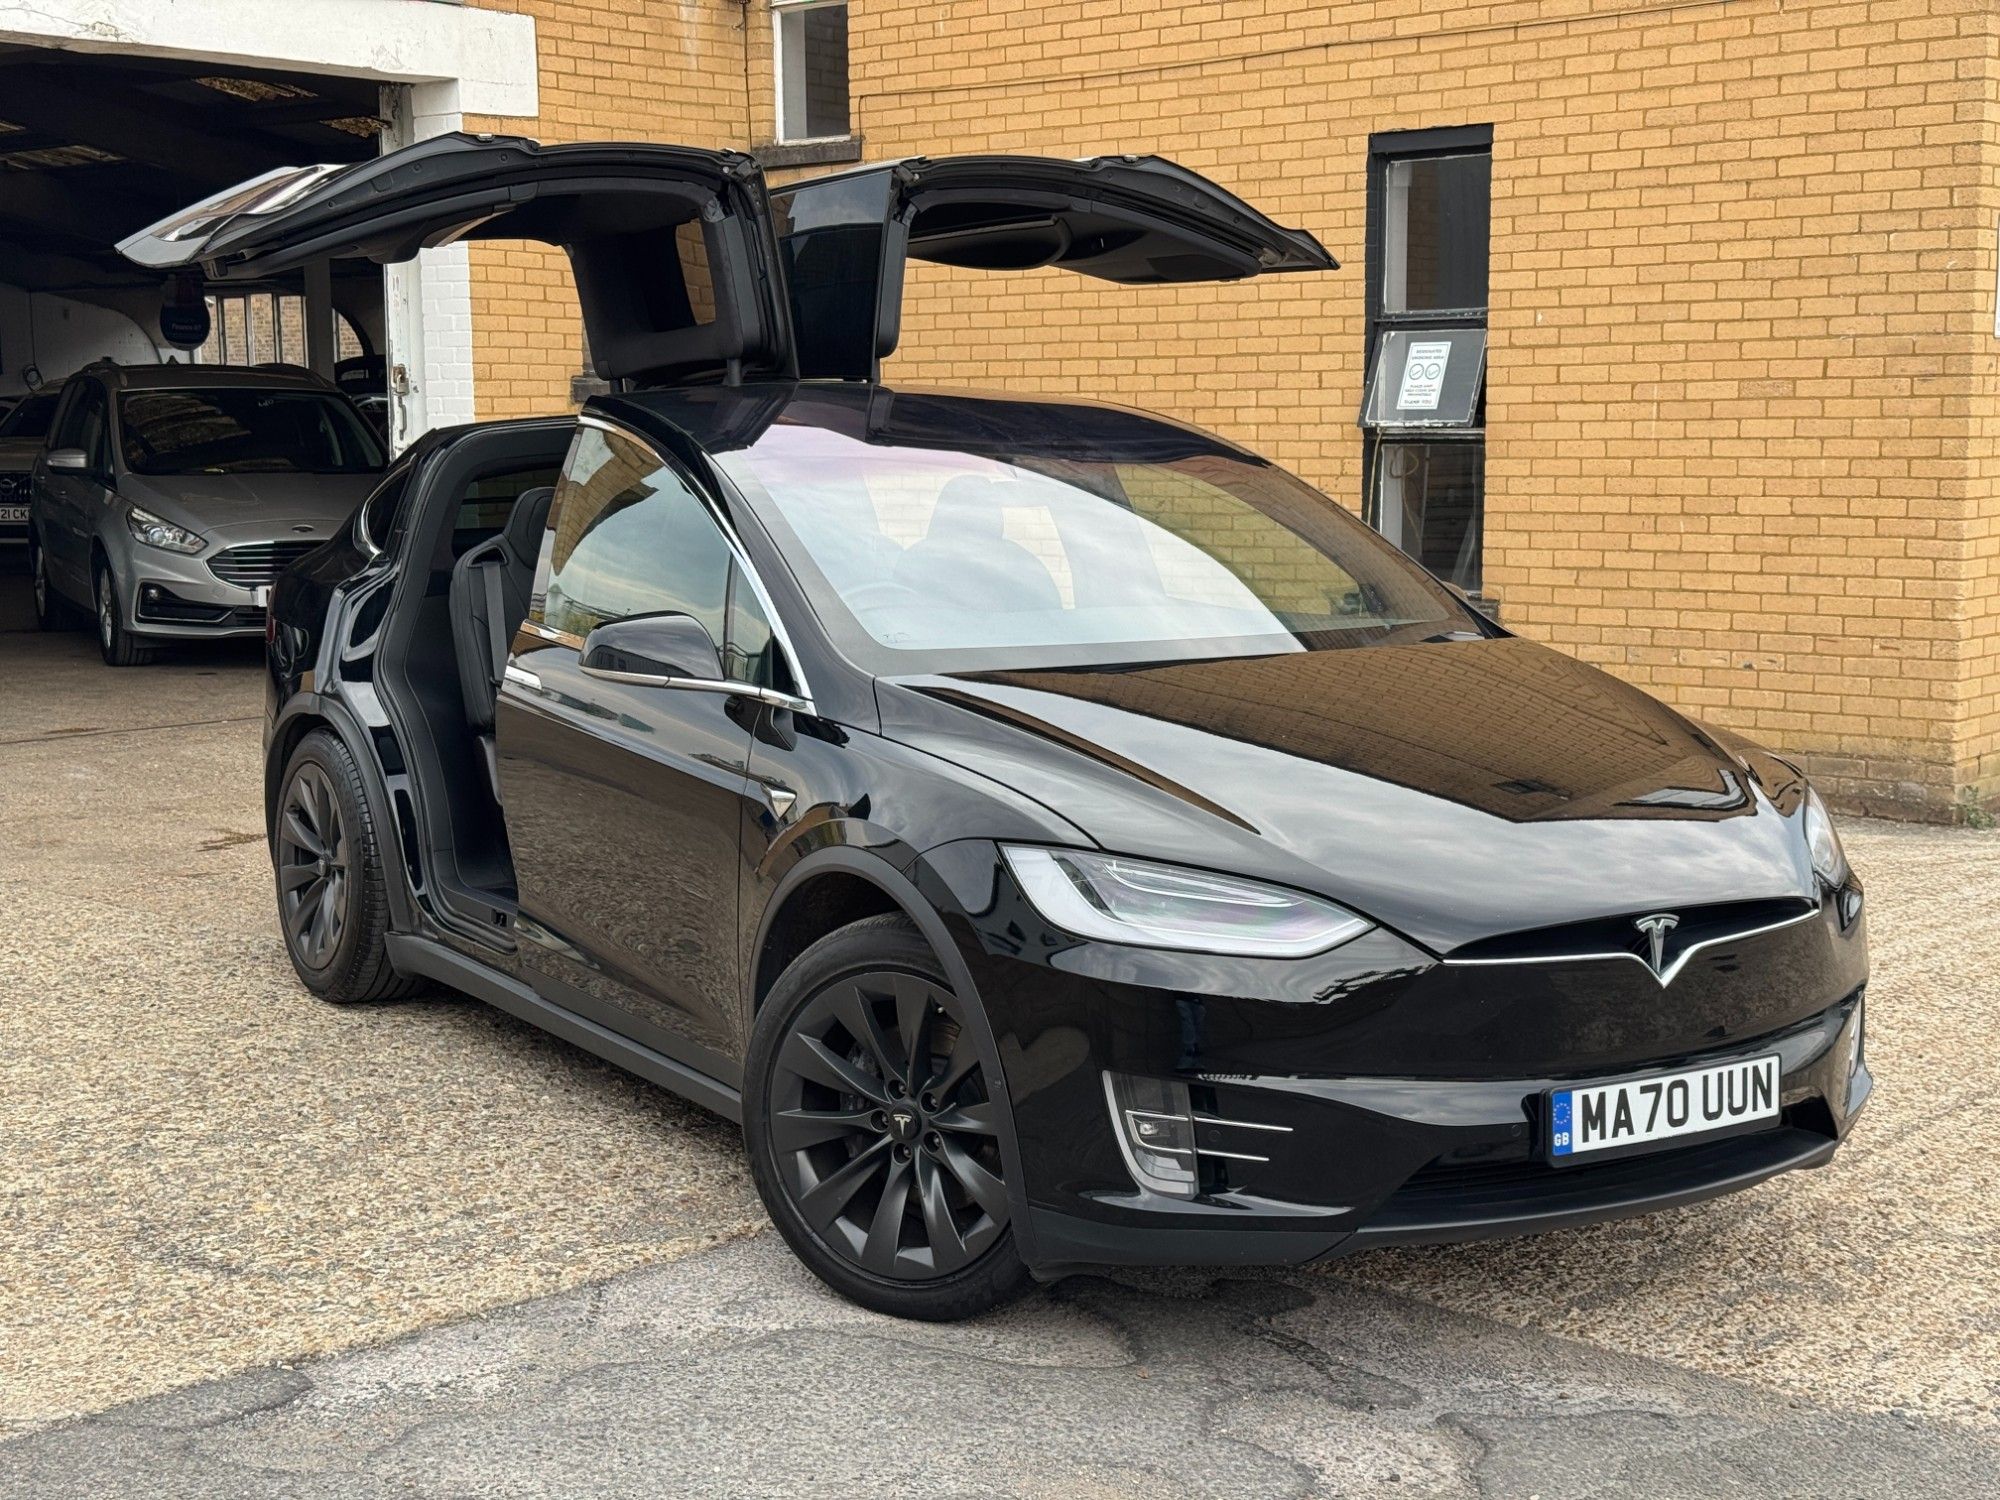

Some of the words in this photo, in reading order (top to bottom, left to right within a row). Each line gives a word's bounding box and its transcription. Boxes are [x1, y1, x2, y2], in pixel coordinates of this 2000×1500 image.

[1581, 1078, 1690, 1144] MA70
[1702, 1062, 1773, 1122] UUN
[1553, 1131, 1570, 1147] GB
